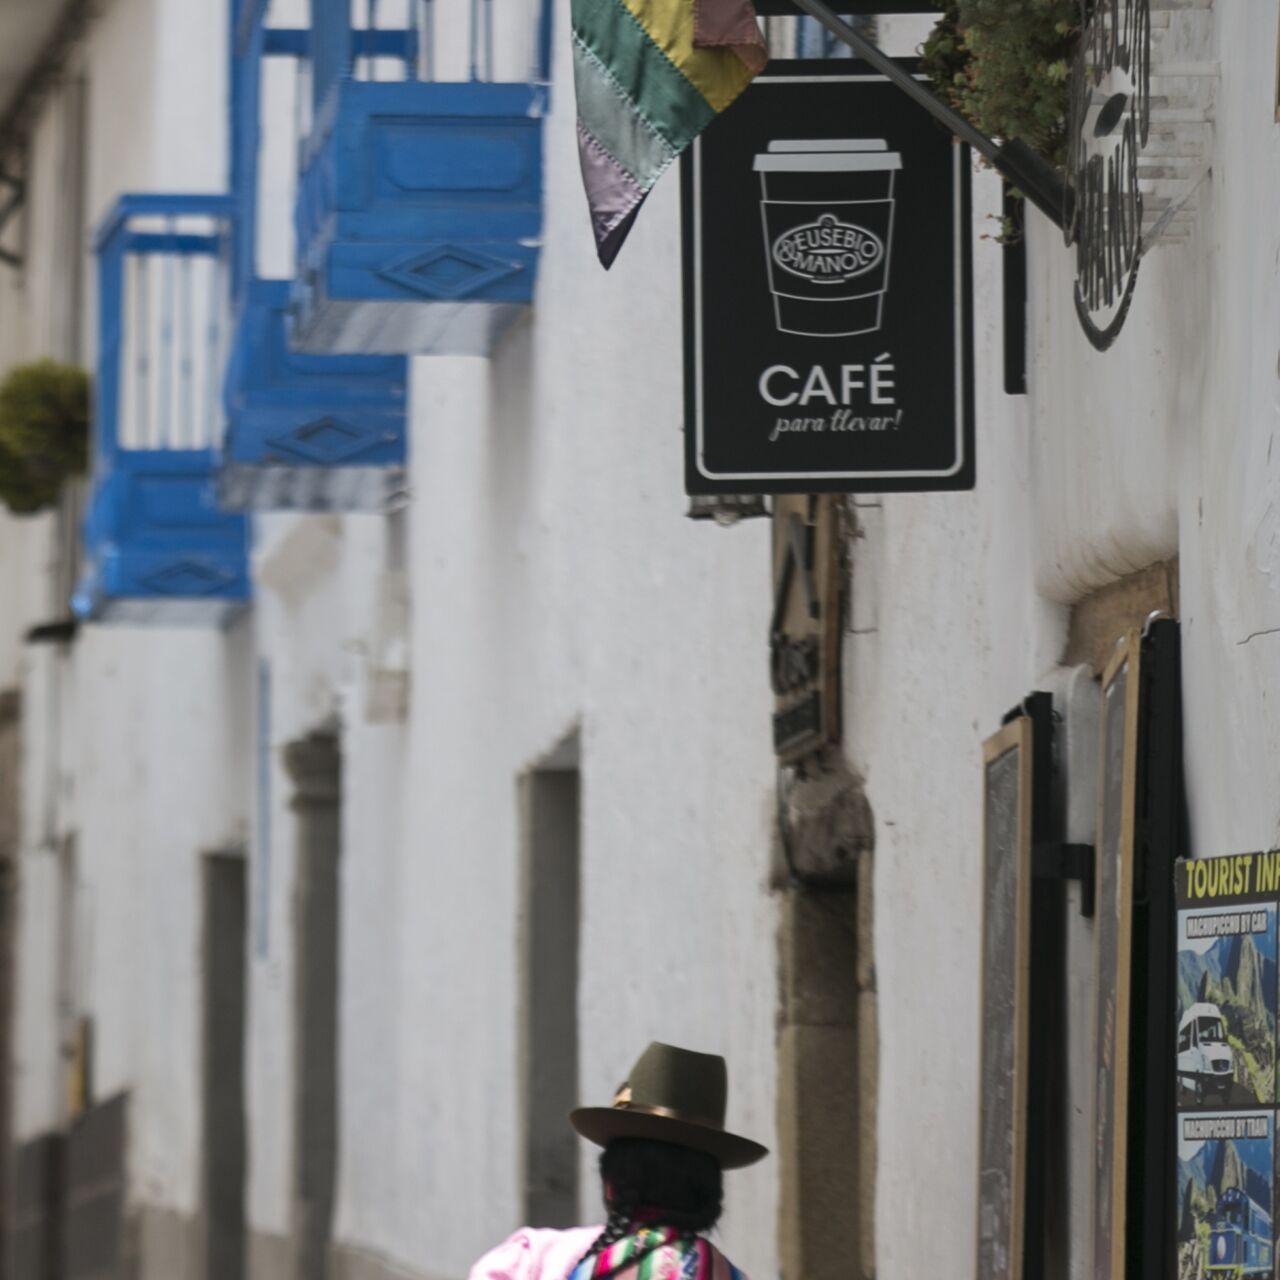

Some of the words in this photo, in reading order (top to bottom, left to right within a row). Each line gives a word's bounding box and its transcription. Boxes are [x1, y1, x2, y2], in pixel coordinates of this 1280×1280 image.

[793, 228, 877, 258] EUSEBIO
[758, 352, 896, 406] CAFÉ
[768, 416, 825, 442] para
[1185, 854, 1253, 899] TOURIST
[1251, 910, 1267, 934] CAR
